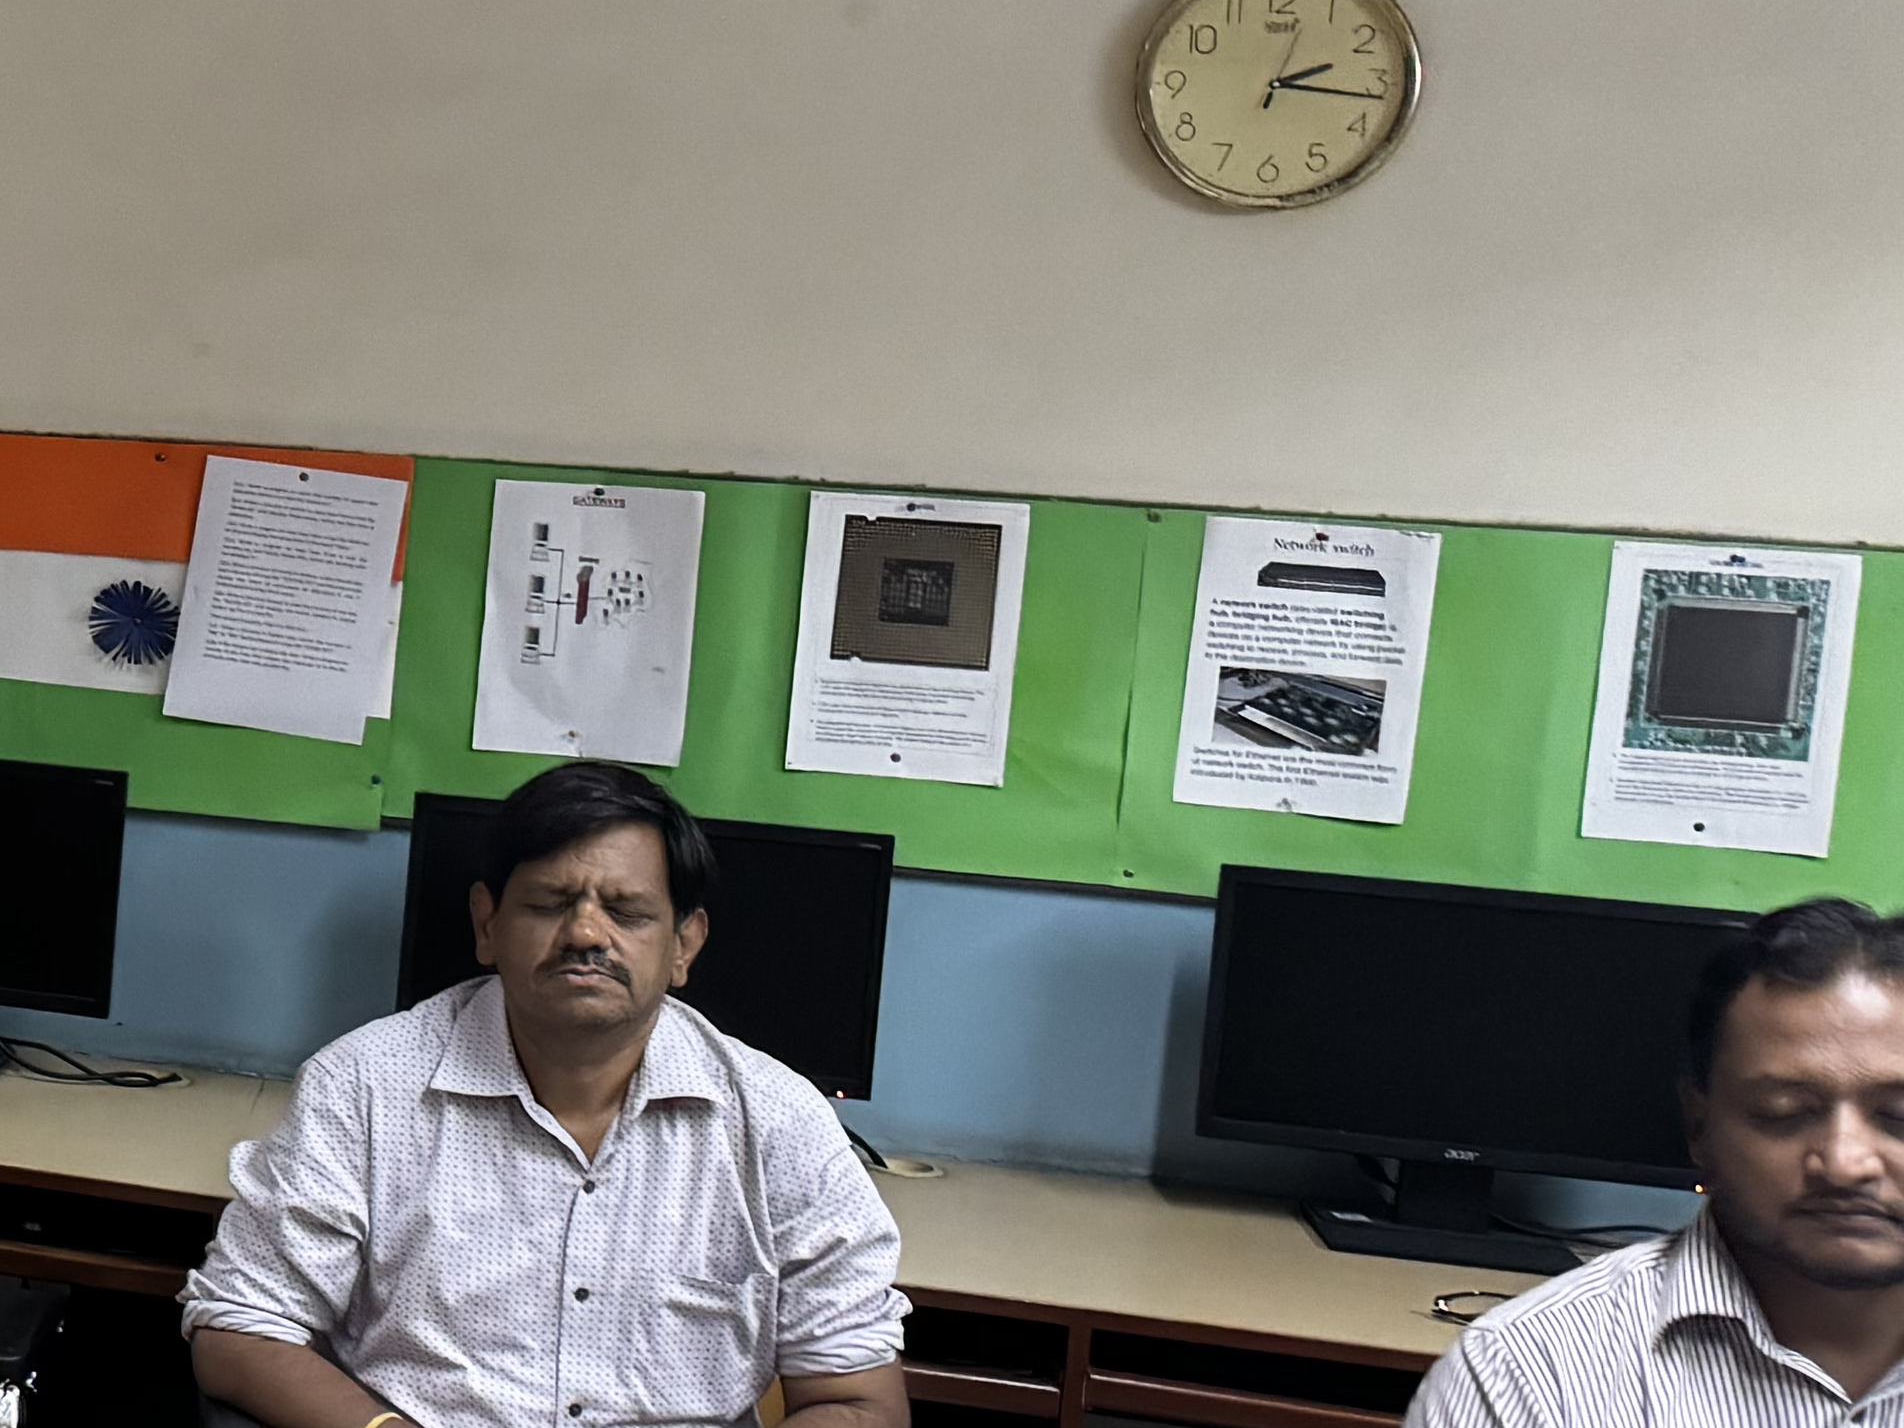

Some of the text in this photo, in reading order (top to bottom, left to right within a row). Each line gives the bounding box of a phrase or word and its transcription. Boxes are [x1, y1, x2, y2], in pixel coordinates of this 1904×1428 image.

[1188, 23, 1217, 54] 10
[1352, 24, 1376, 54] 2
[1164, 70, 1187, 100] 9
[1366, 67, 1388, 97] 3
[1175, 111, 1196, 141] 8
[1347, 112, 1367, 138] 4
[1212, 142, 1232, 172] 7
[1256, 154, 1279, 183] 6
[1305, 142, 1327, 173] 5
[1274, 537, 1375, 557] Network switch
[1444, 1148, 1480, 1162] acer
